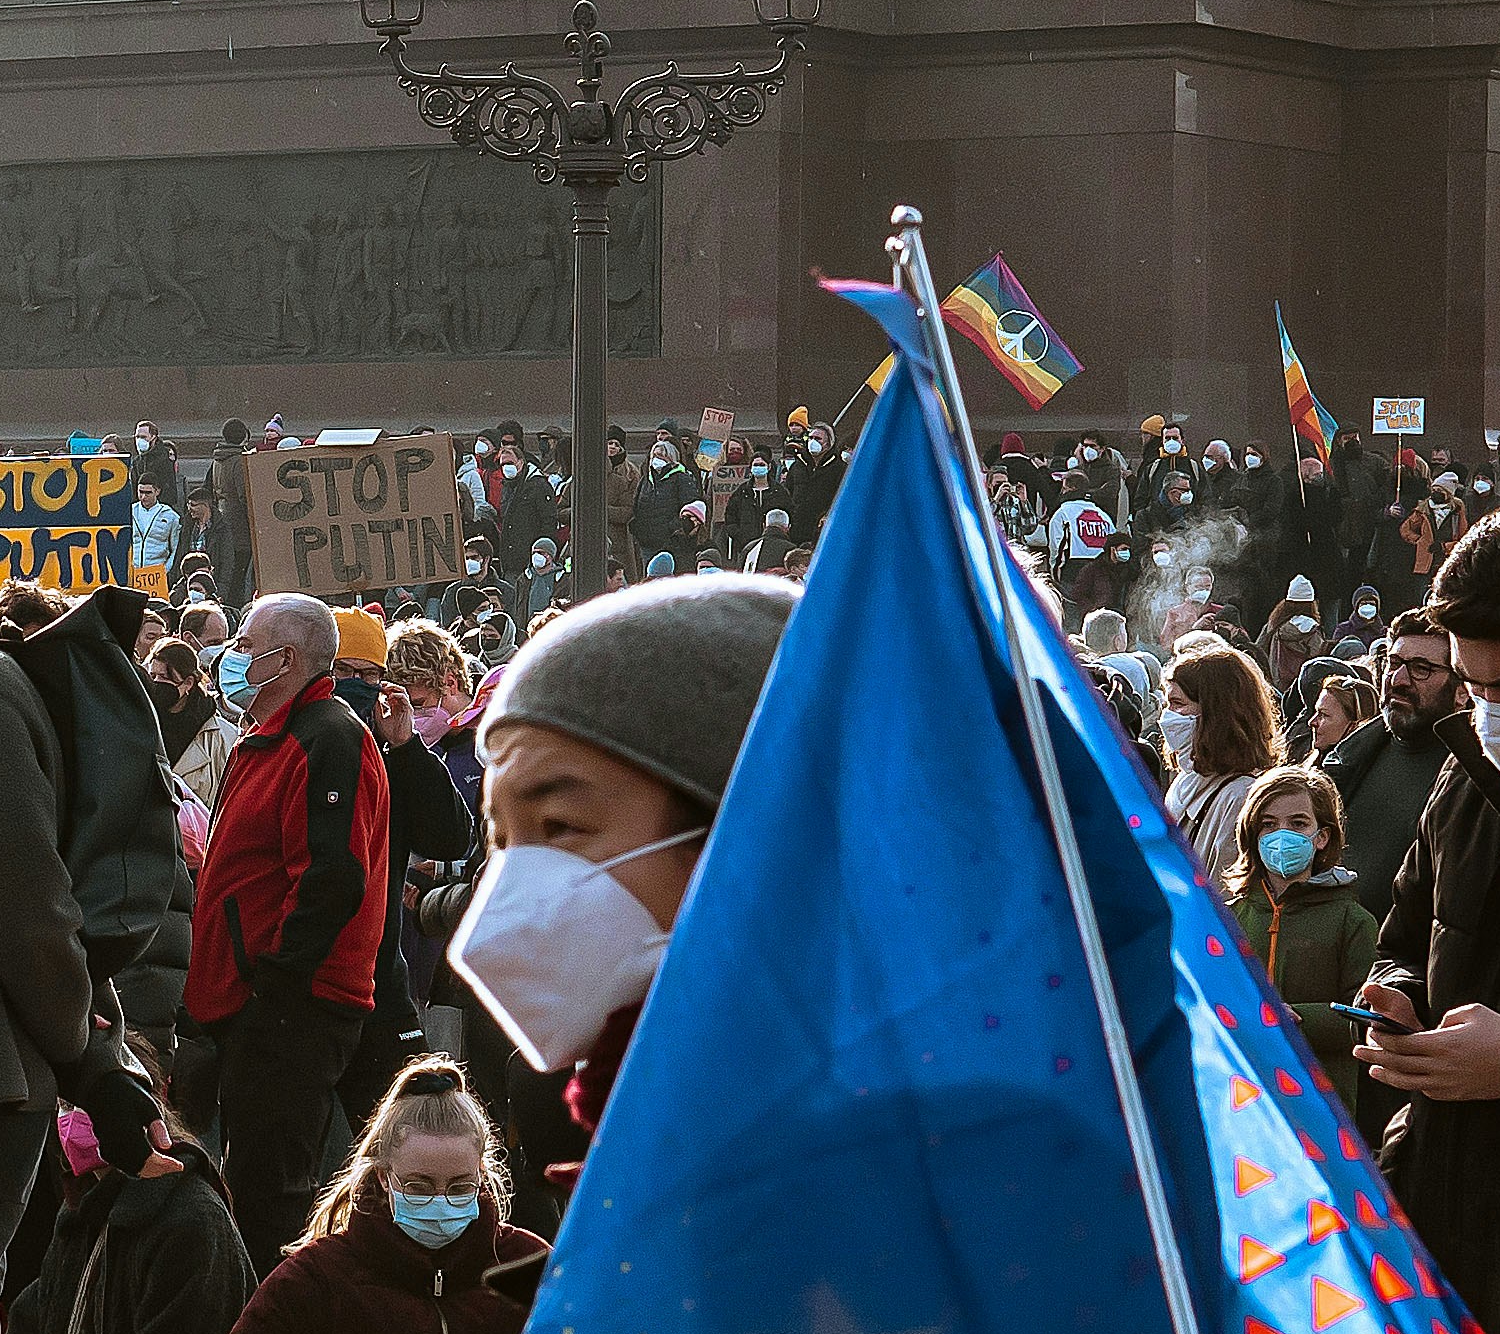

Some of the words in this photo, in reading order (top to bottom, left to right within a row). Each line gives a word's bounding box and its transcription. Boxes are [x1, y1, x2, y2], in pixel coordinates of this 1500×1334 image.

[1378, 399, 1421, 414] STOP
[704, 409, 733, 424] STOP
[1375, 414, 1422, 430] WAR
[272, 447, 436, 522] STOP
[1079, 519, 1111, 538] PUTIN
[293, 512, 458, 588] PUTIN
[135, 571, 161, 588] STOP
